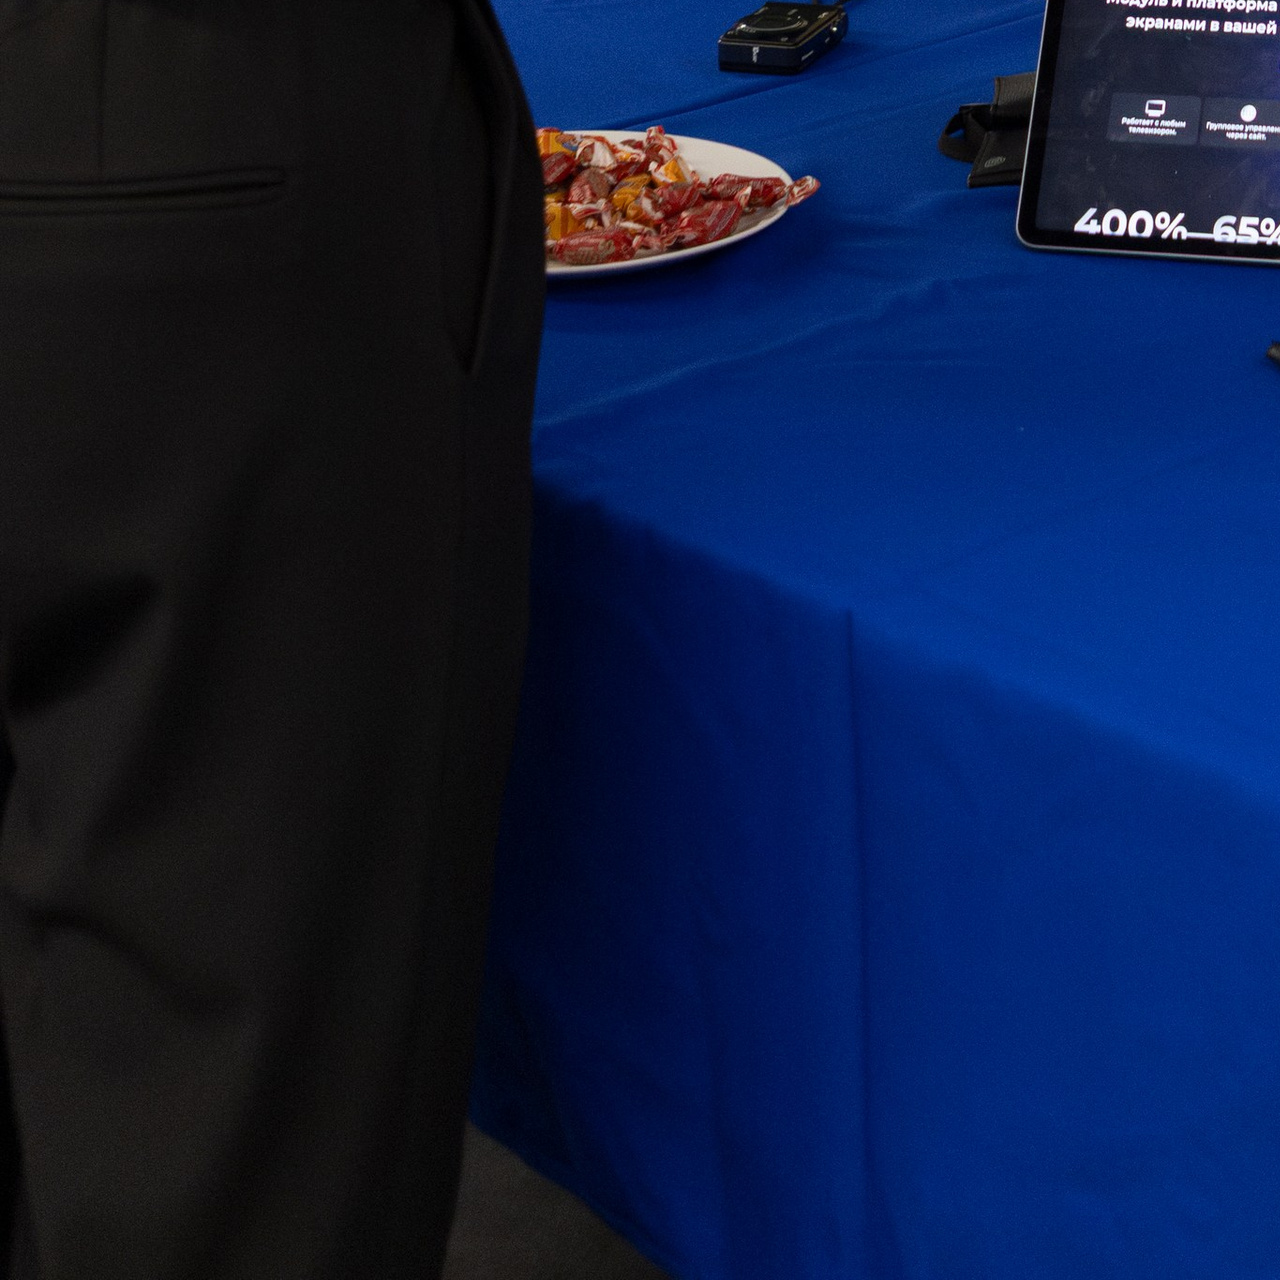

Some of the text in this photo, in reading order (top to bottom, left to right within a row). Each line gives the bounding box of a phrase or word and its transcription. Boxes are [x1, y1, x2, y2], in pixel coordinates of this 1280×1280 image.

[1125, 15, 1206, 32] экранами
[1210, 21, 1220, 32] в
[1223, 20, 1277, 35] вашей
[1074, 207, 1187, 241] 400%
